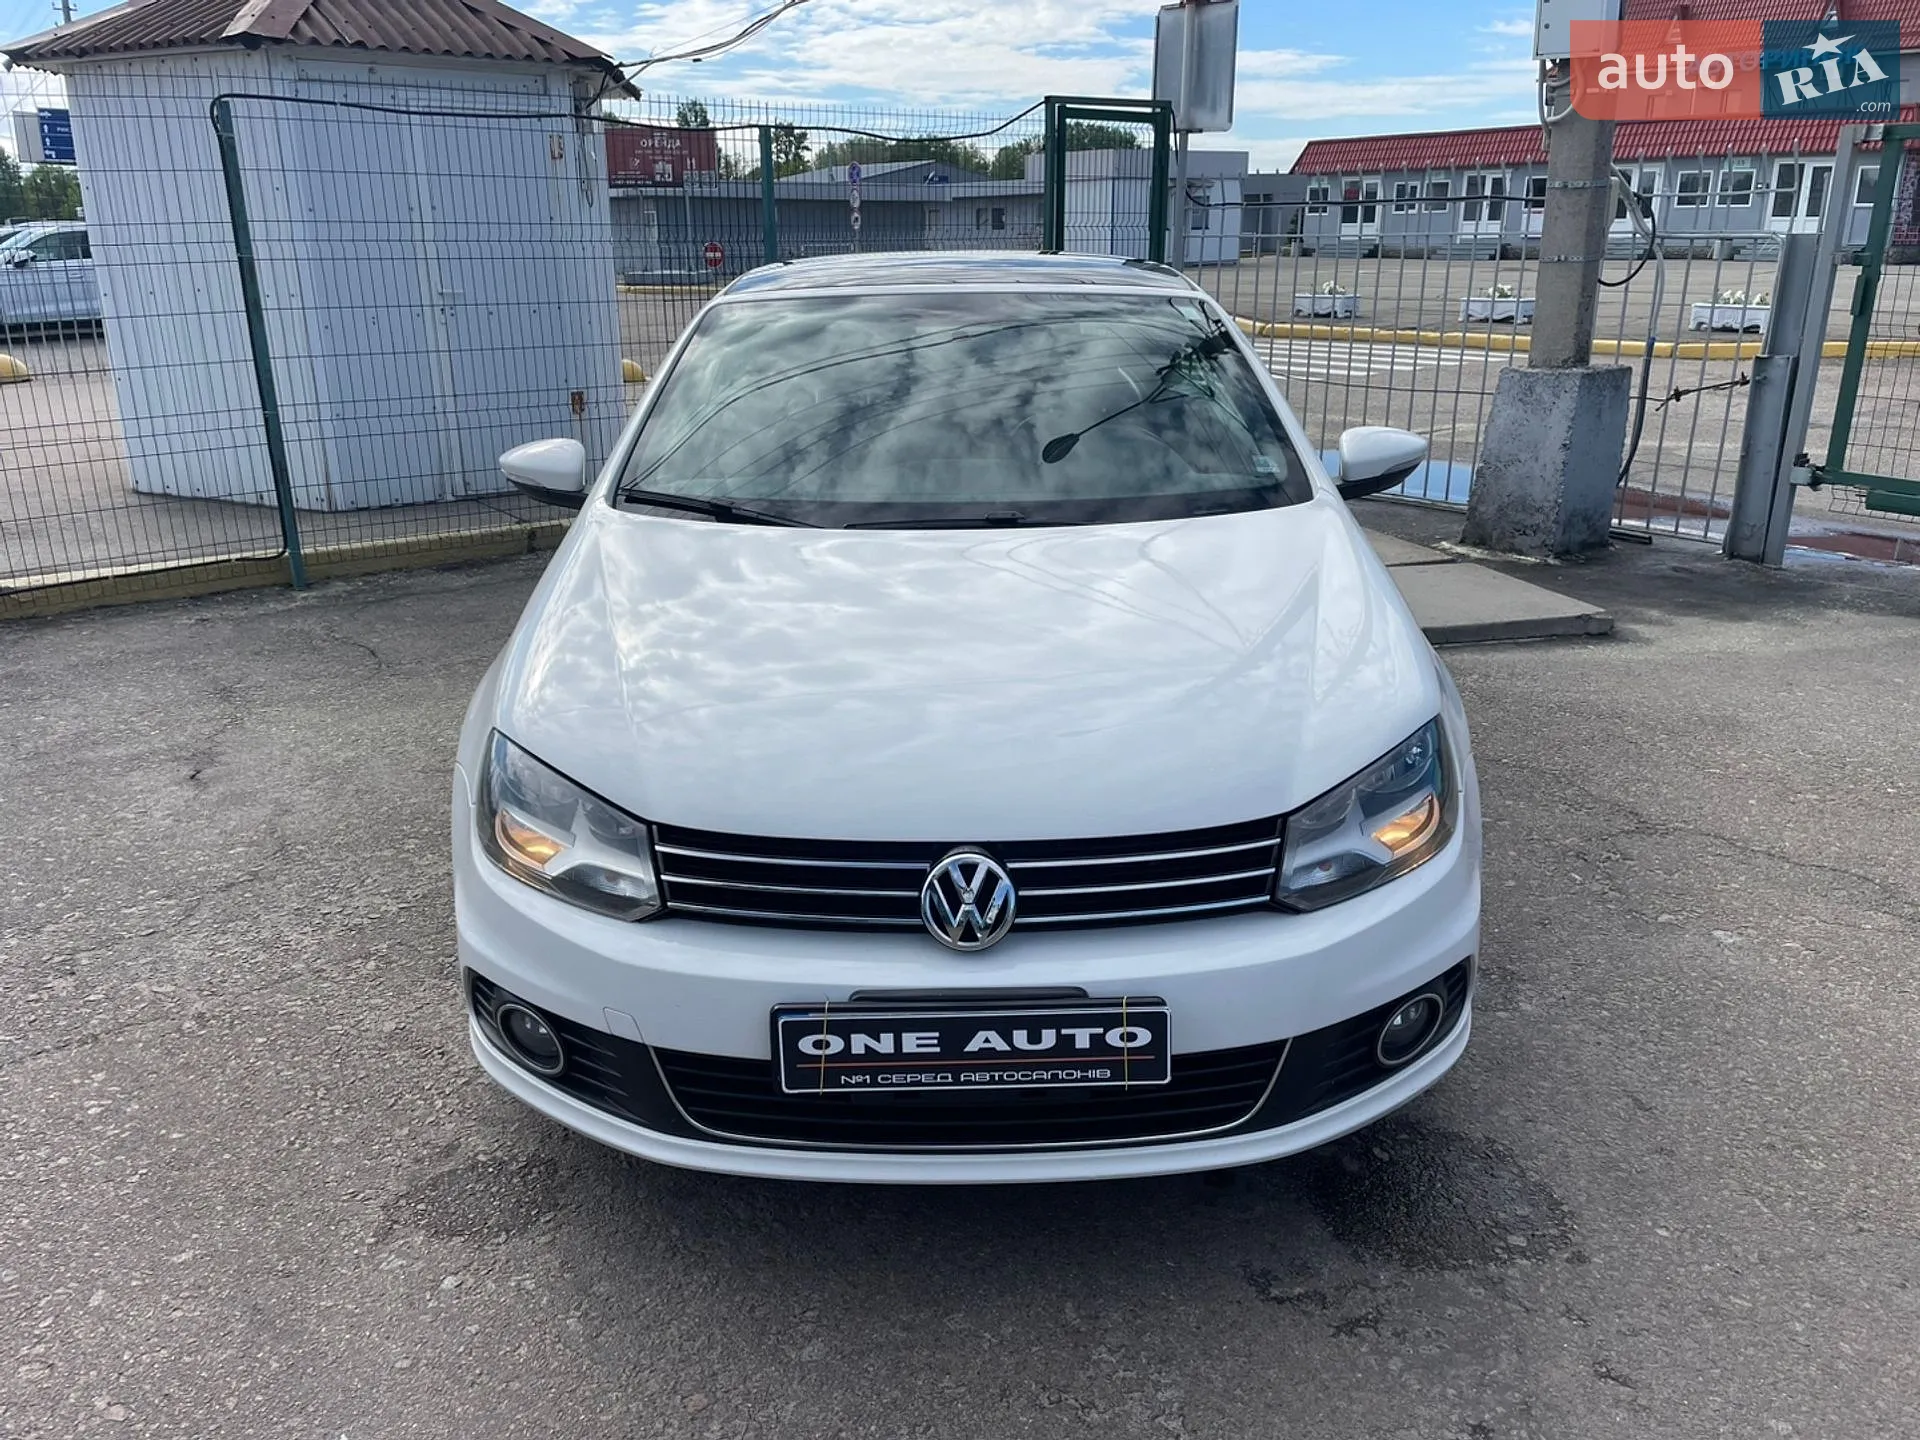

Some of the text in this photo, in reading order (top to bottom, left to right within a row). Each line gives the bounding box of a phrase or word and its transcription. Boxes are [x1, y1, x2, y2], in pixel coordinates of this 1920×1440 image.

[797, 1026, 1153, 1056] ONE AUTO
[878, 1072, 953, 1084] СЕРЕД
